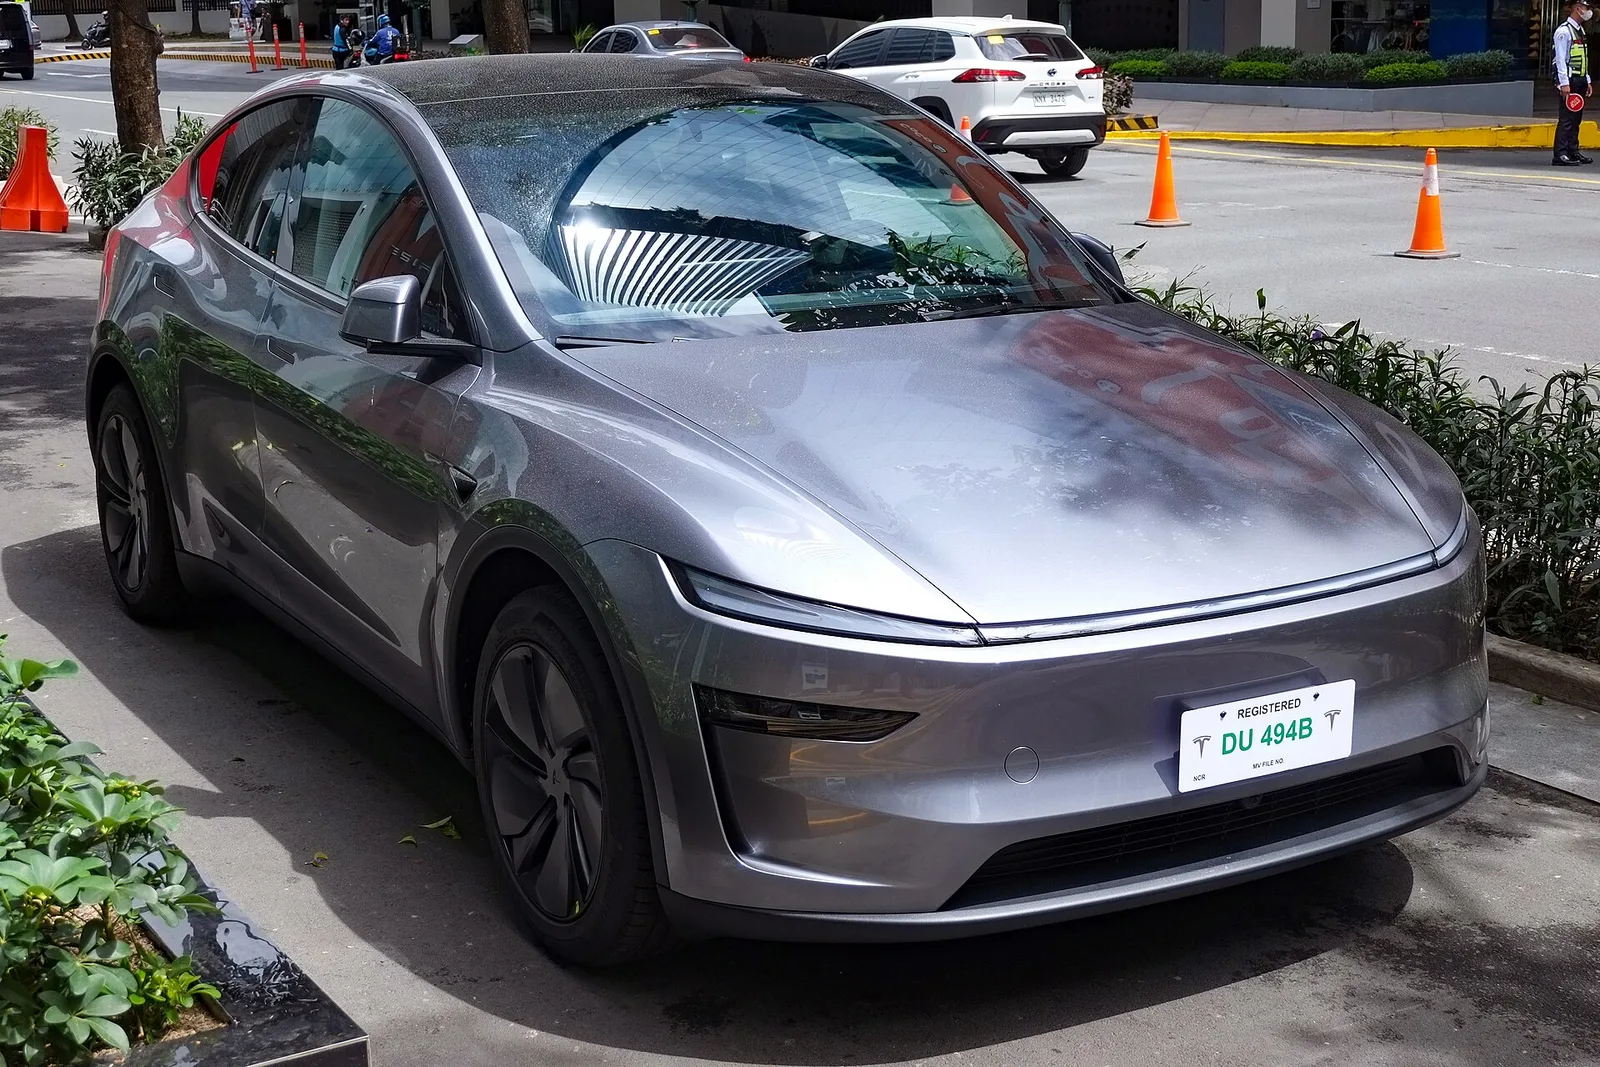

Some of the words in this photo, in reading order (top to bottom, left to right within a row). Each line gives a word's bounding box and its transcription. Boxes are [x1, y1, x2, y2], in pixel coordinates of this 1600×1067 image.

[1237, 698, 1302, 719] REGISTERED
[1222, 728, 1254, 756] DU
[1260, 717, 1313, 747] 494B
